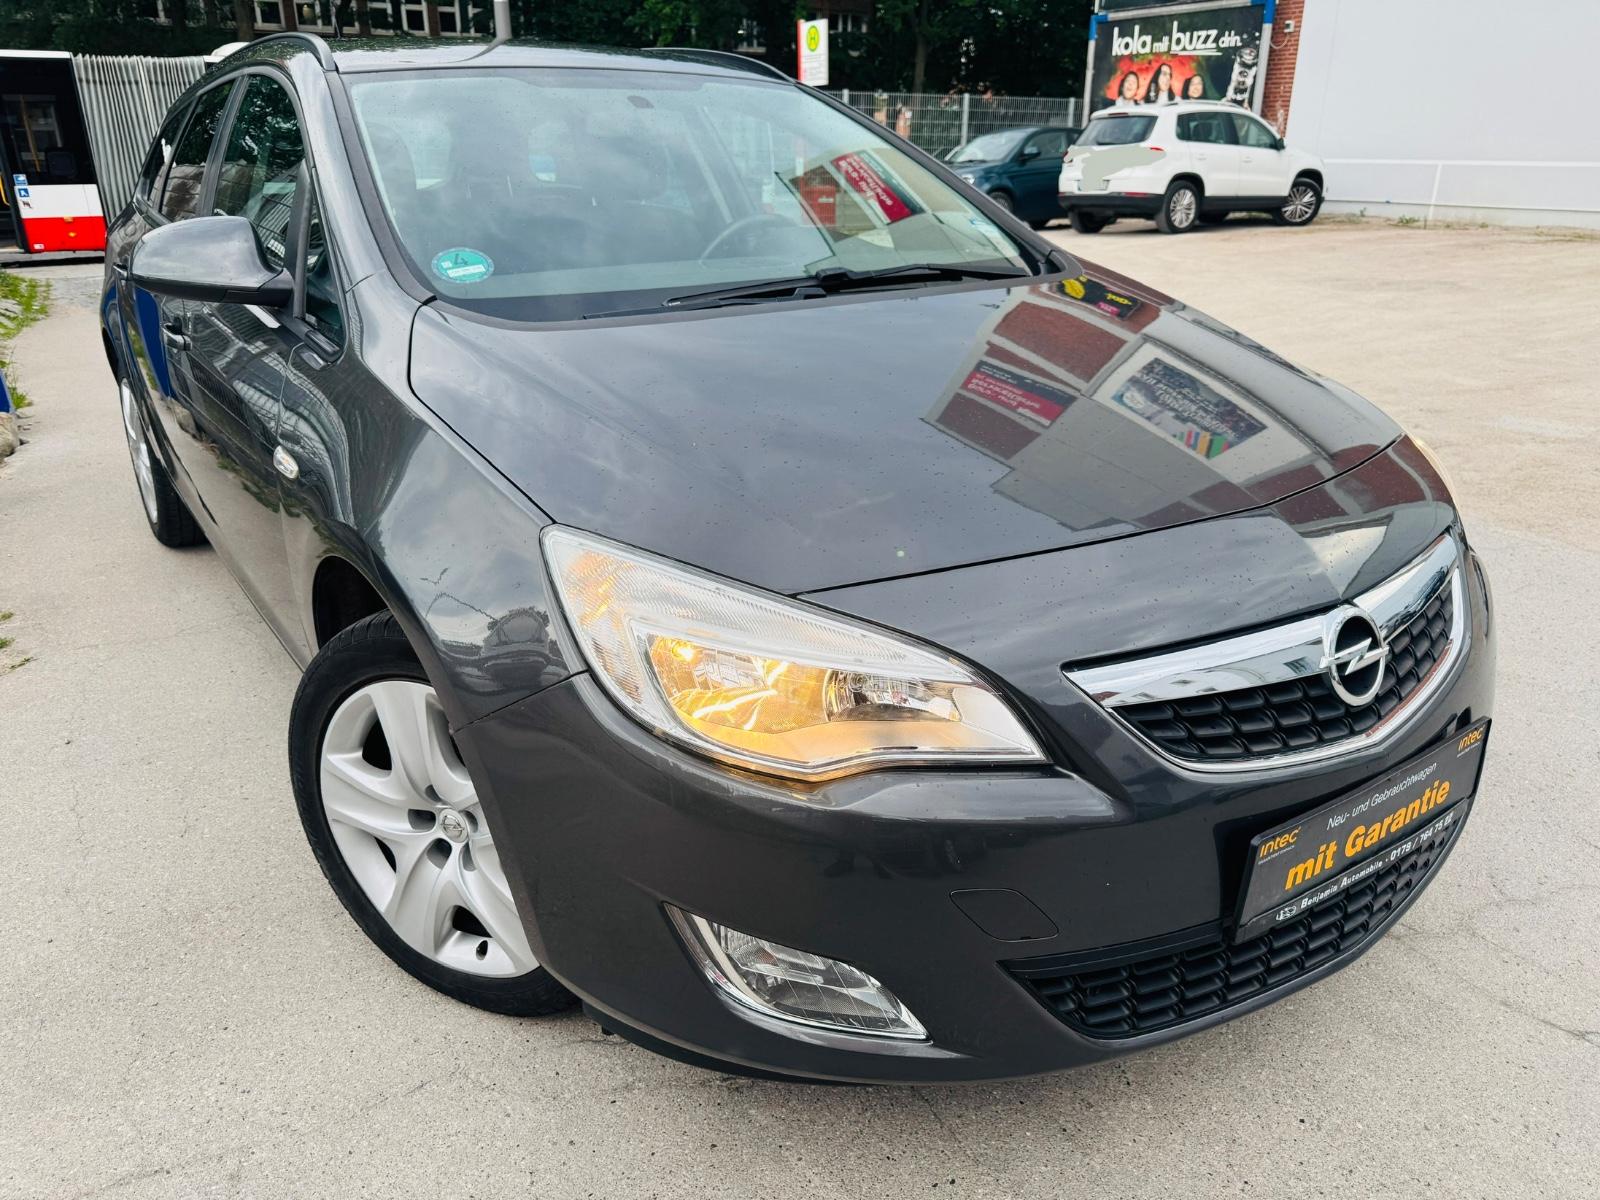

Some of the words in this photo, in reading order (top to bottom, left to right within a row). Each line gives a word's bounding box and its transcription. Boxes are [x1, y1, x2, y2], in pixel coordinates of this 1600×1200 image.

[1112, 25, 1152, 56] kola
[1171, 20, 1219, 51] buzz
[1327, 814, 1350, 830] Neu-
[1352, 798, 1370, 816] und
[1371, 762, 1437, 806] Gebrauchtwagen
[1260, 829, 1299, 857] intec
[1285, 841, 1337, 890] mit
[1345, 780, 1450, 857] Garantie
[1301, 884, 1338, 909] Benjamin
